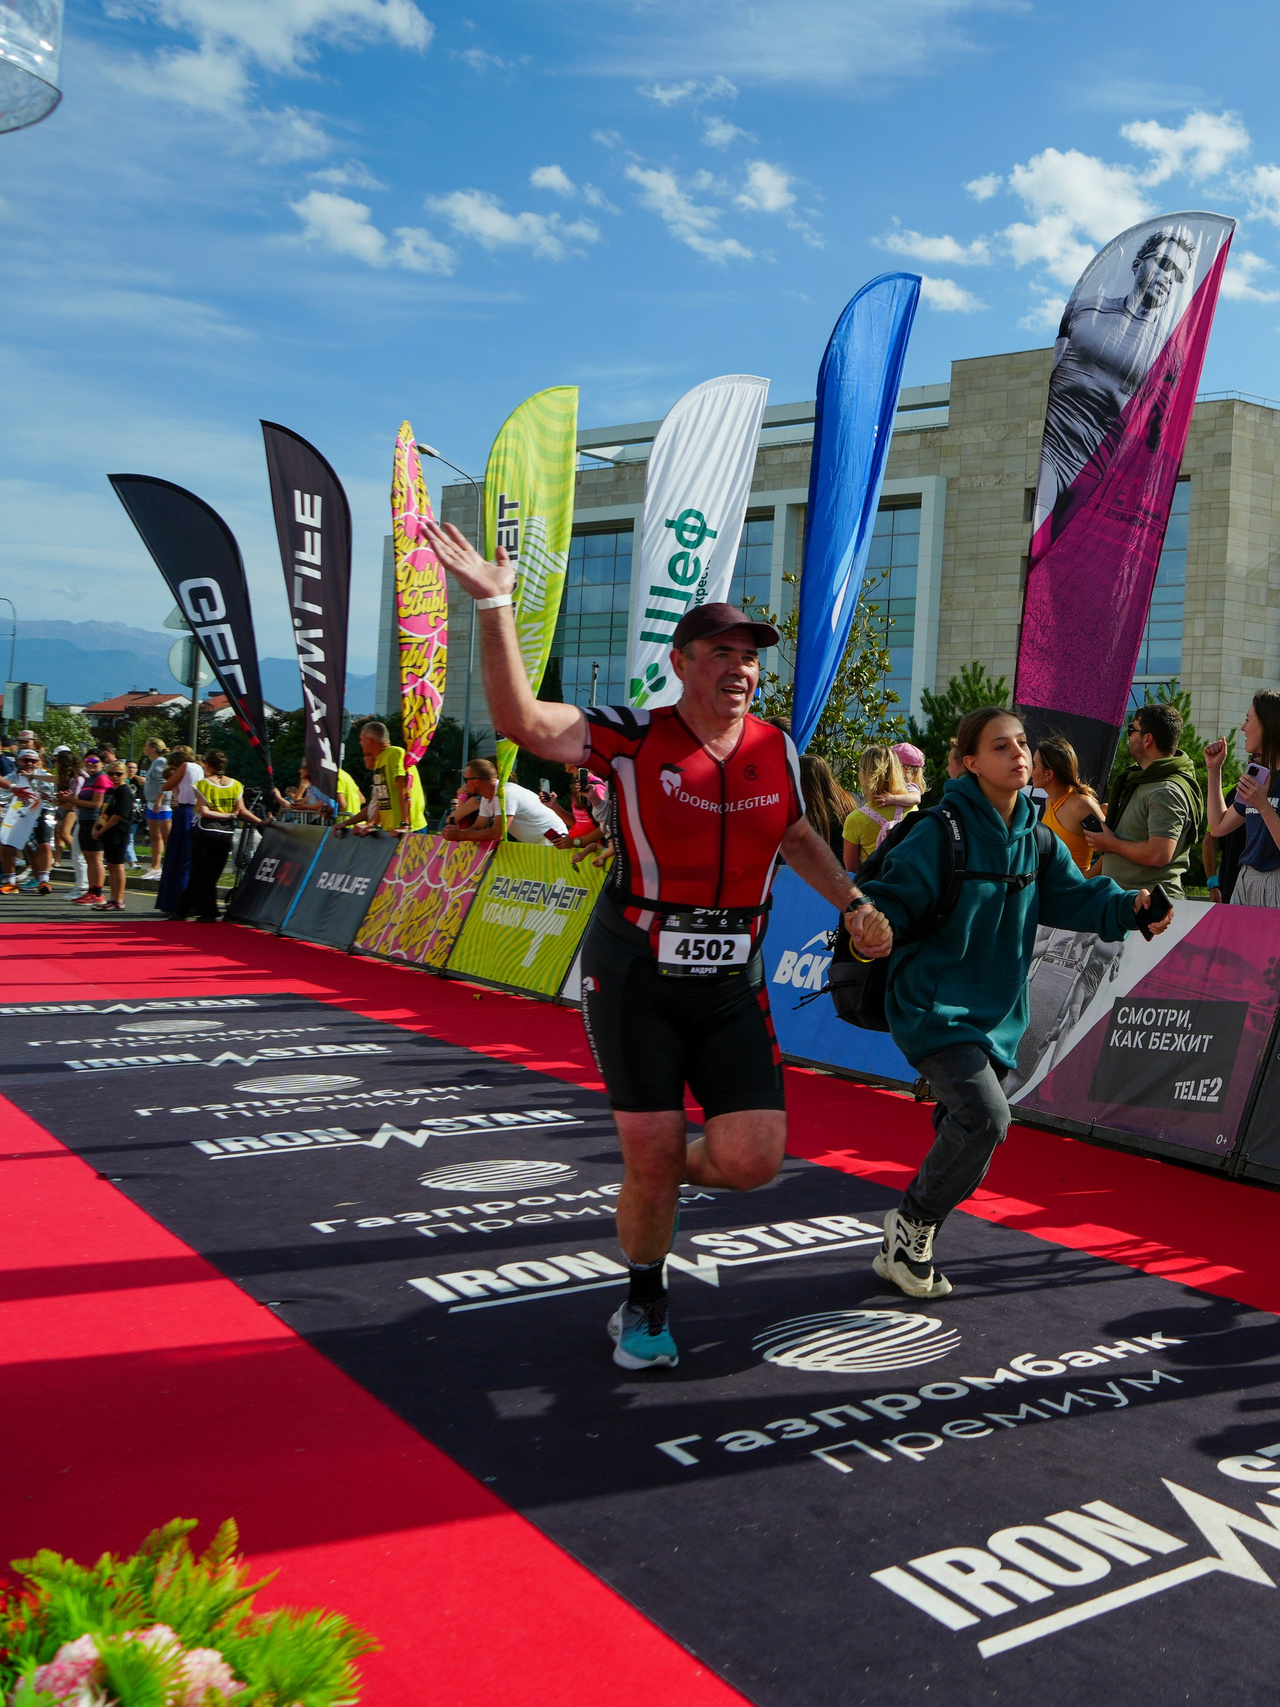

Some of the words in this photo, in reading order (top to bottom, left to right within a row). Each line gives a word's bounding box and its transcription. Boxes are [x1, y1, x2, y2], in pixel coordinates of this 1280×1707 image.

[679, 791, 780, 814] DOBROLEGTEAM
[488, 876, 589, 912] FAHRENHEIT
[481, 901, 525, 928] VITAMIN
[675, 938, 736, 961] 4502
[690, 965, 718, 975] АНДРЕЙ
[145, 998, 257, 1008] STAR
[1117, 1006, 1193, 1031] СМОТРИ,
[26, 1026, 332, 1047] Газпромбанк
[1110, 1029, 1146, 1049] КАК
[1148, 1032, 1213, 1053] БЕЖИТ
[63, 1053, 206, 1071] IRON
[254, 1042, 388, 1057] STAR
[134, 1083, 495, 1118] Газпромбанк
[1174, 1077, 1223, 1102] TELE2
[211, 1094, 462, 1120] Премиум
[190, 1126, 363, 1155] IRON
[419, 1109, 578, 1132] STAR
[406, 1250, 631, 1304] IRON
[690, 1213, 886, 1257] STAR
[655, 1330, 1188, 1467] Газпромбанк
[810, 1368, 1184, 1475] Премиум
[870, 1499, 1189, 1632] IRON
